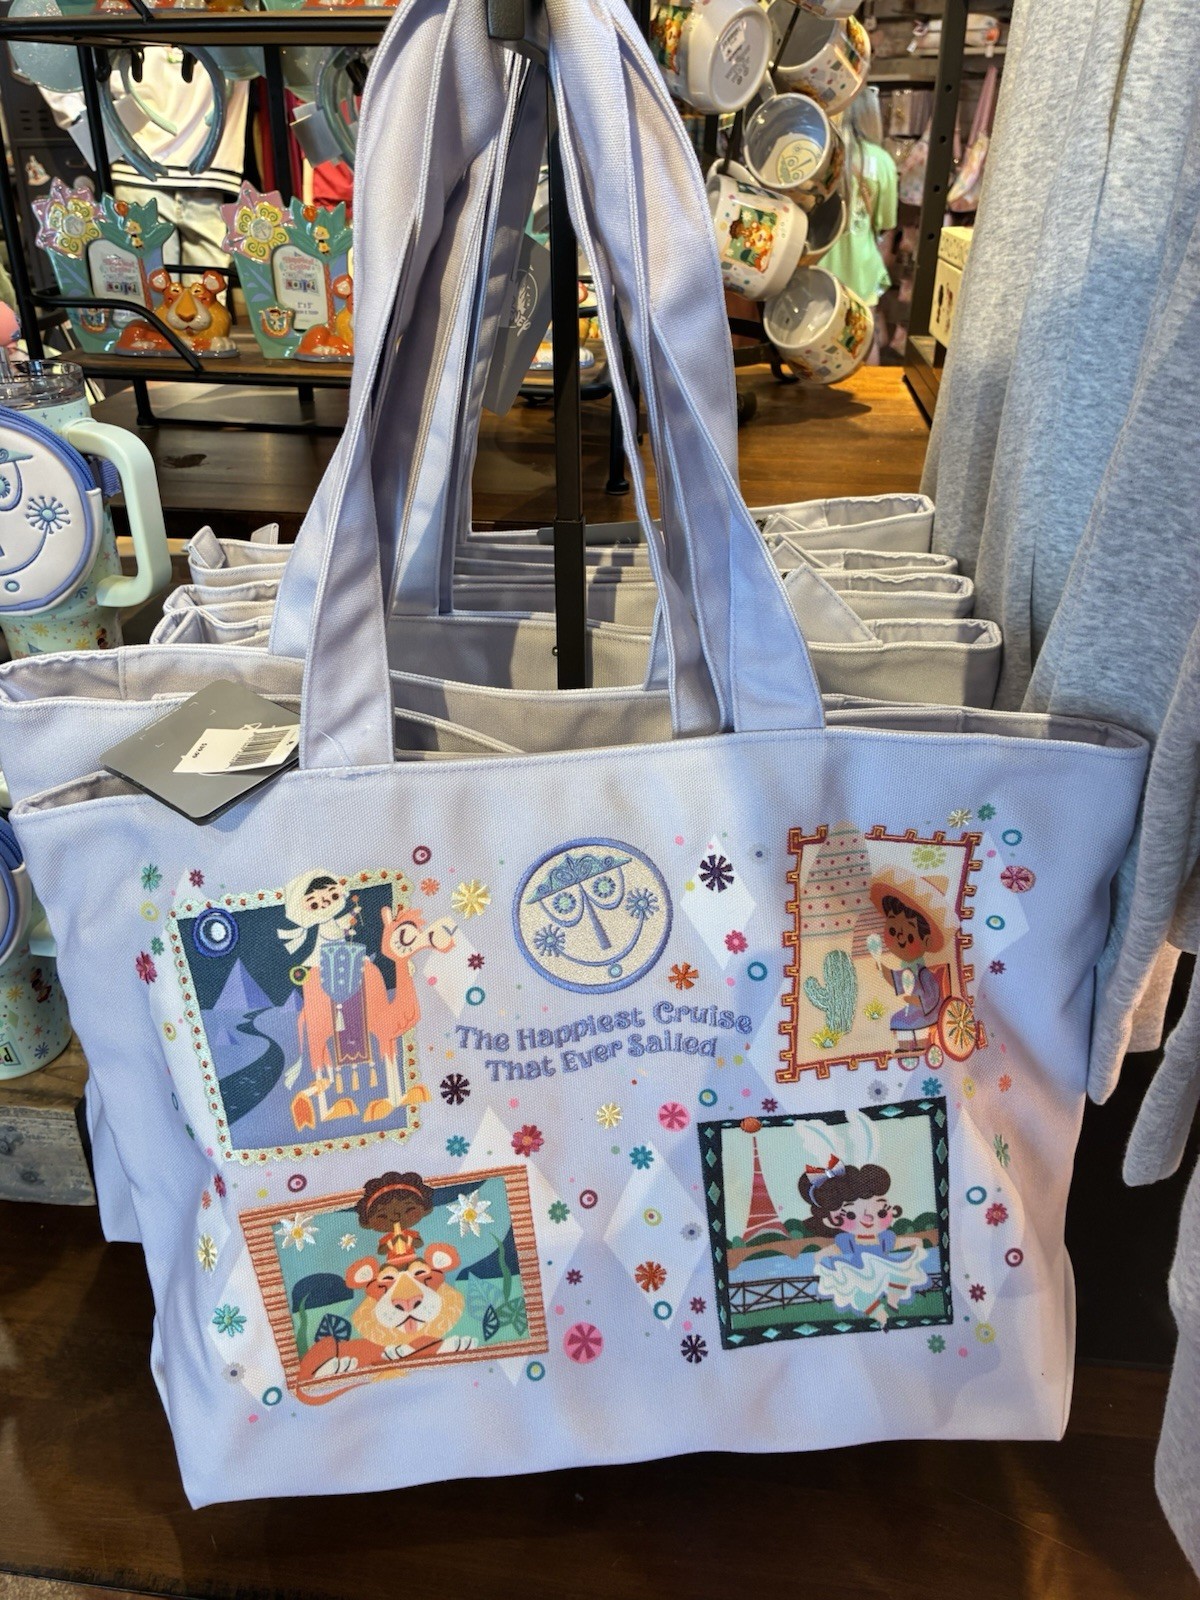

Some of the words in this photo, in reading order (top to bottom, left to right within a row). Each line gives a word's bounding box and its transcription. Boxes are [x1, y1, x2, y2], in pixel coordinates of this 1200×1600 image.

[455, 1024, 510, 1052] The
[516, 1008, 646, 1051] Happiest
[652, 1000, 753, 1034] Cruise
[484, 1055, 556, 1082] That
[560, 1041, 623, 1073] Ever
[627, 1029, 718, 1058] Sailed
